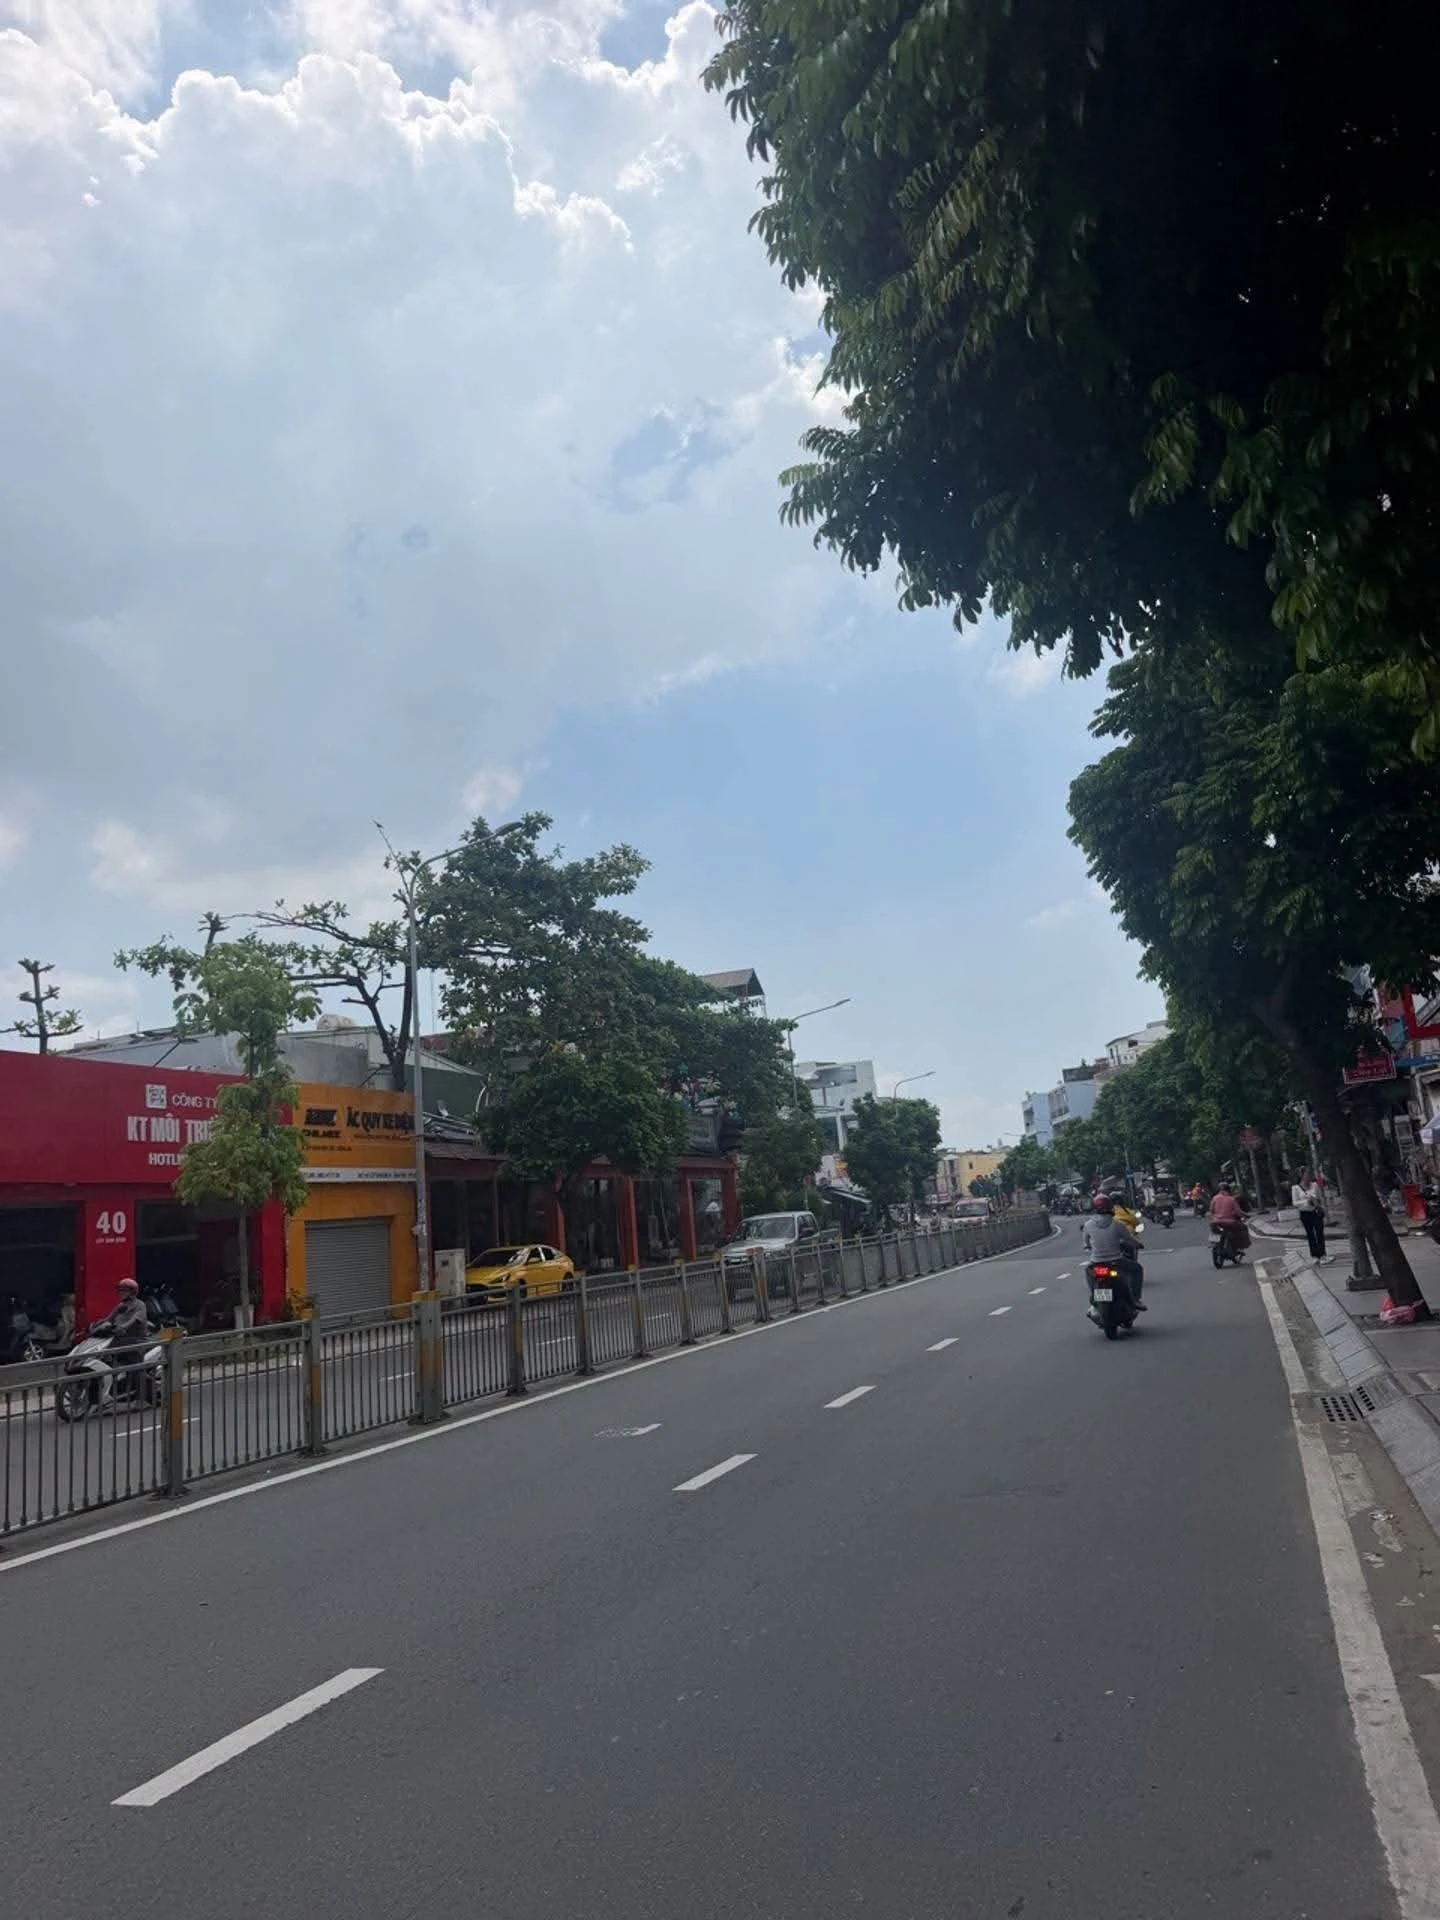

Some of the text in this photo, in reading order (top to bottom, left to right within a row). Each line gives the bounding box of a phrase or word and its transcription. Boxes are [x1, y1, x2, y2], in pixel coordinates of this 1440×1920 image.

[172, 1092, 202, 1108] CÔNG
[127, 1116, 147, 1141] KT
[150, 1112, 180, 1143] MÔI
[96, 1211, 126, 1234] 40
